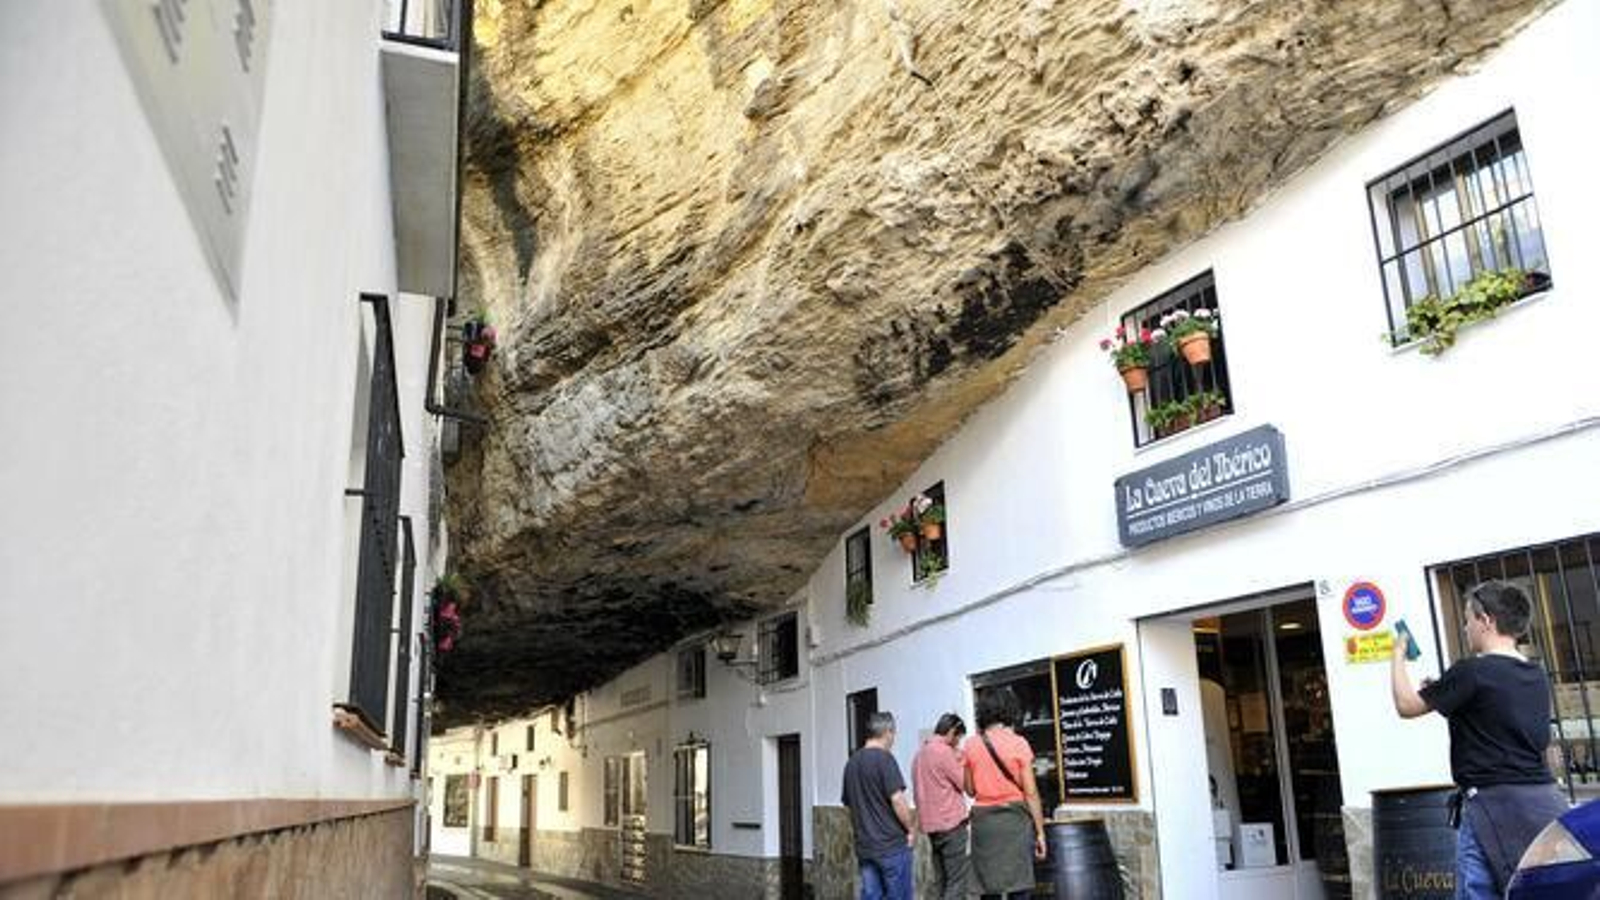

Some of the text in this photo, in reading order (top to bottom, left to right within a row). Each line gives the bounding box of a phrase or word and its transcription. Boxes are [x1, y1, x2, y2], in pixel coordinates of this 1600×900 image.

[1126, 444, 1271, 512] La Cueva del Ibérico
[1234, 489, 1245, 506] LA
[1245, 481, 1274, 501] TIERRA
[1402, 864, 1455, 893] Cueva
